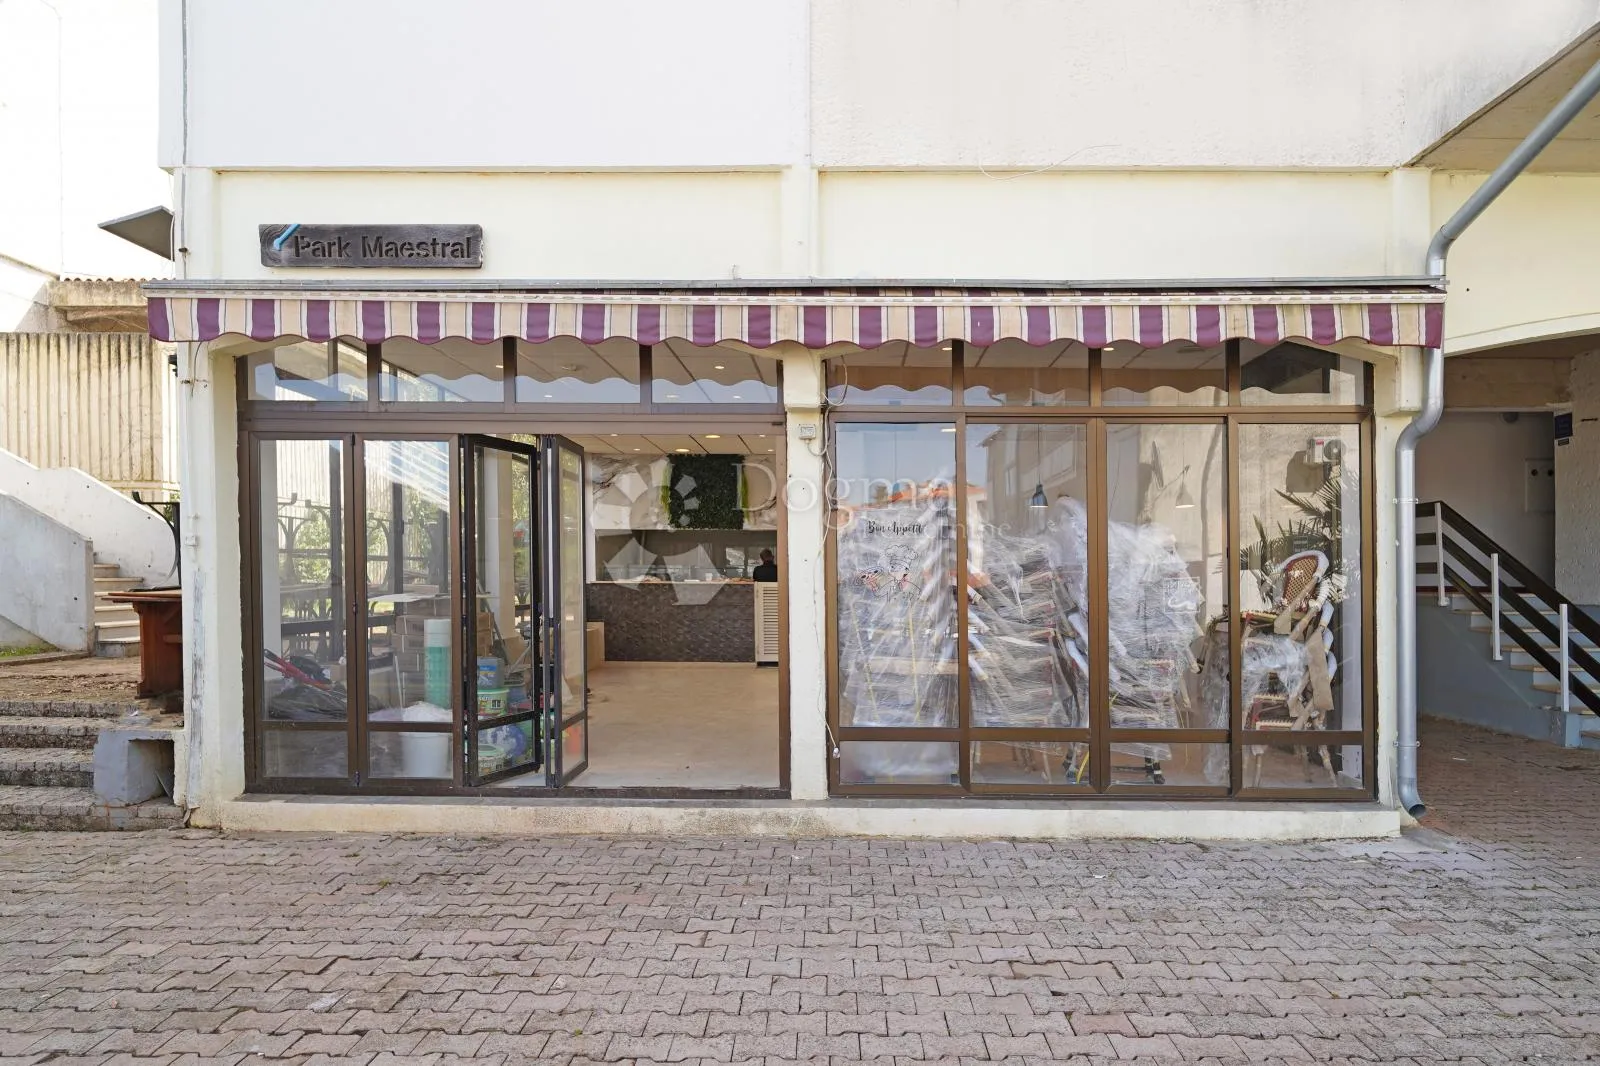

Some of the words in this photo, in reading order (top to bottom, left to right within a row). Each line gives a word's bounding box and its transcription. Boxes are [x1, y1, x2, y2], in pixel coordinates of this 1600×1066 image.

[294, 235, 352, 258] Park
[361, 235, 472, 258] Maestral
[867, 520, 885, 534] Bon
